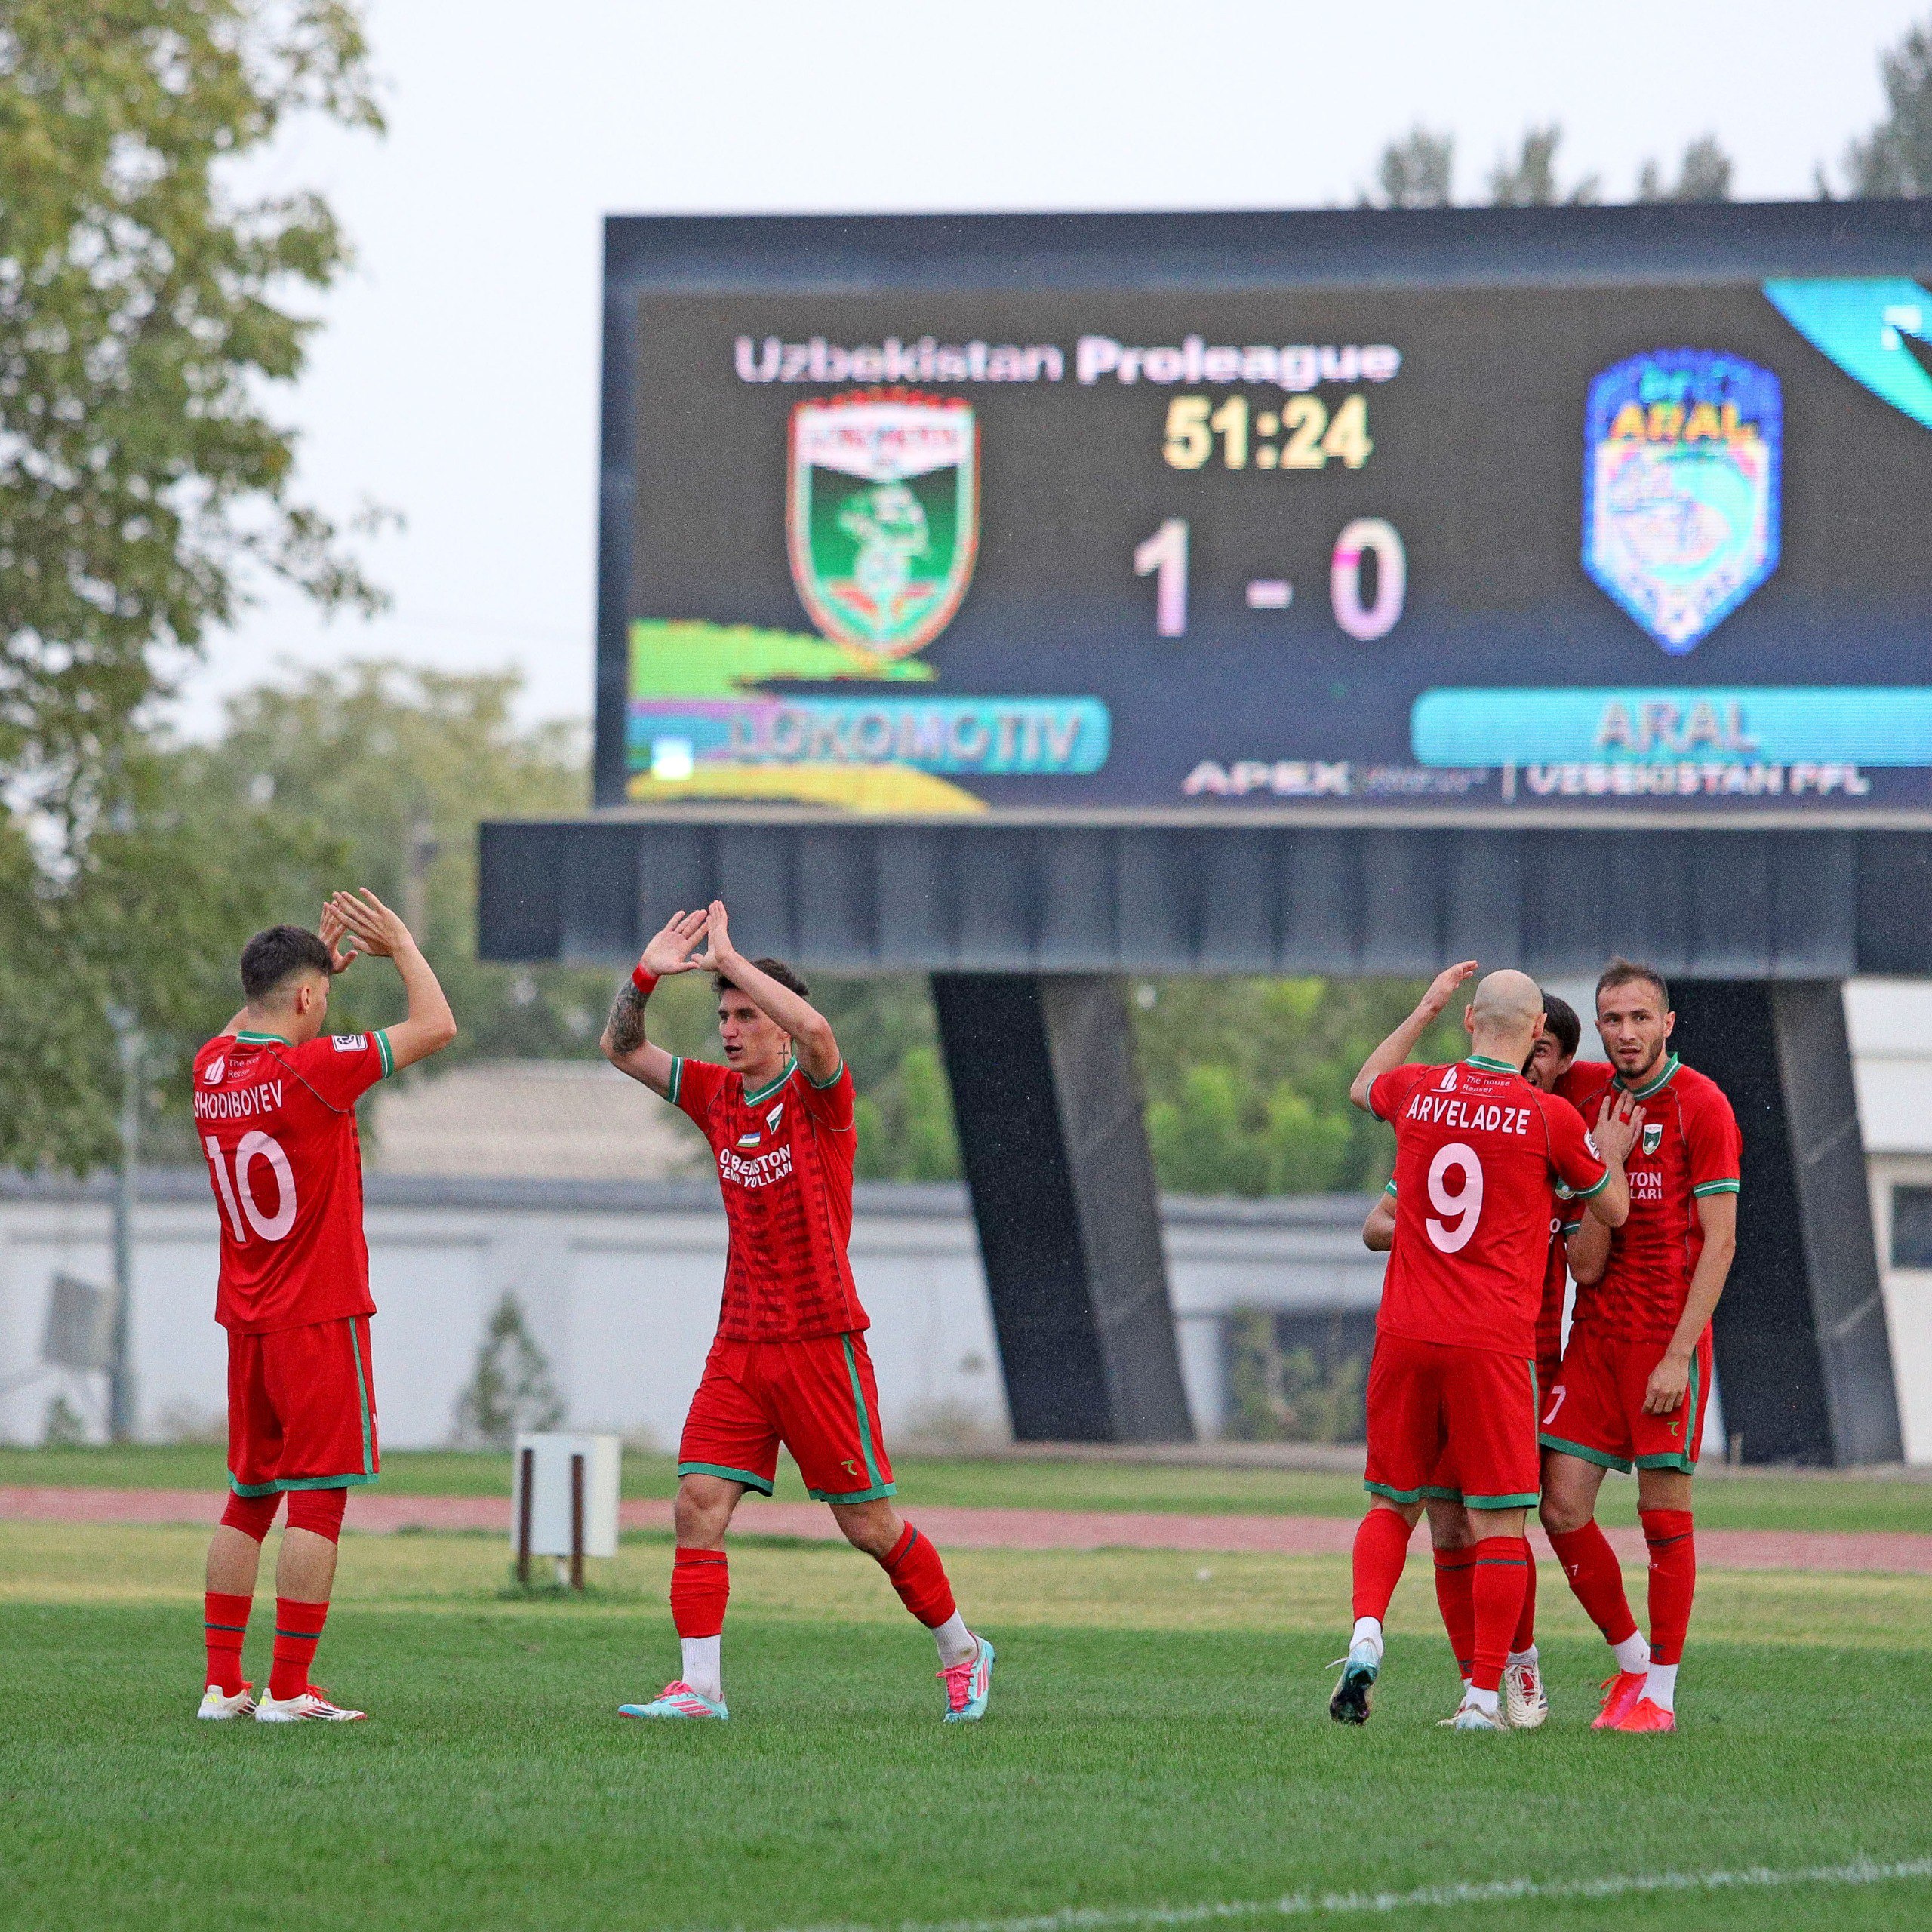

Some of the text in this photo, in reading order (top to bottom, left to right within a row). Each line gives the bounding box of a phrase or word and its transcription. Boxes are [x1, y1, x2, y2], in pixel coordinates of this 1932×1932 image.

[734, 334, 1403, 391] Uzbekistan Proleague
[1162, 394, 1374, 469] 51:24
[1133, 516, 1190, 638] 1
[1329, 515, 1408, 641] 0
[1595, 699, 1761, 753] ARAL
[1181, 760, 1352, 796] APEX
[1406, 1094, 1531, 1135] ARVELADZE
[205, 1130, 297, 1243] 10
[1426, 1143, 1484, 1254] 9
